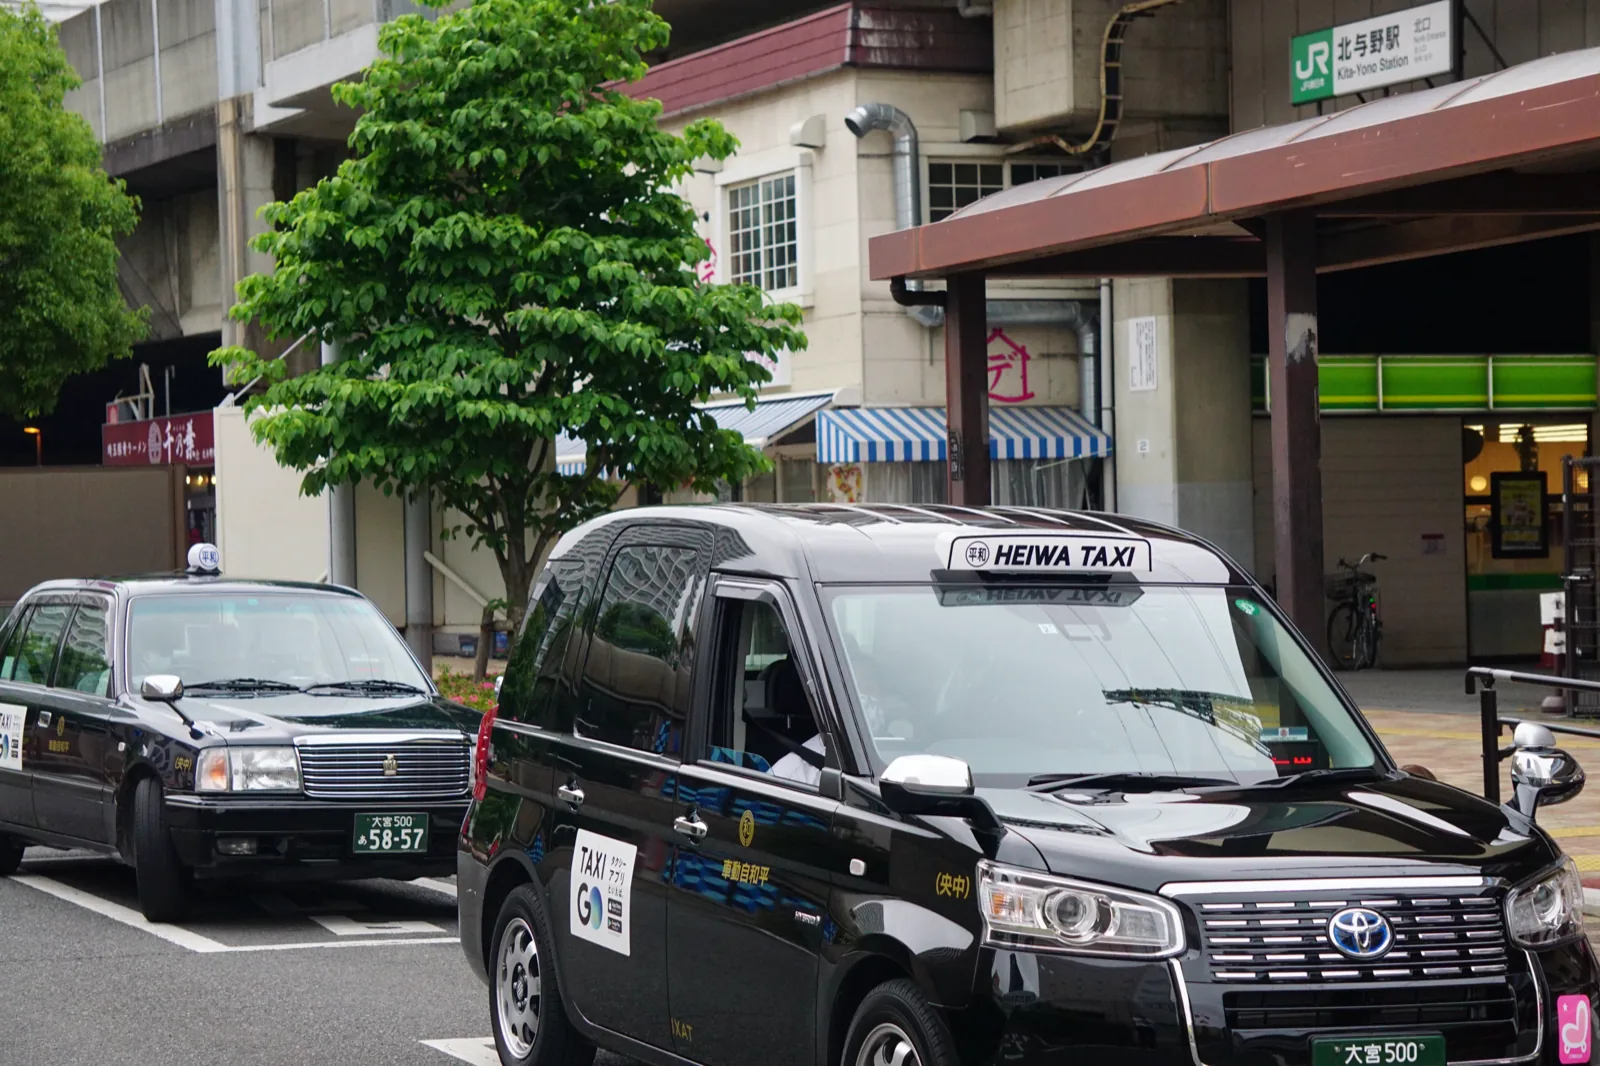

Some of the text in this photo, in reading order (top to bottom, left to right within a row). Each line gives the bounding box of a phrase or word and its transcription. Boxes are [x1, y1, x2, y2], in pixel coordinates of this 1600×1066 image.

[1413, 17, 1431, 33] 北口
[1338, 24, 1400, 62] 北与野駅
[1296, 41, 1330, 79] JR
[1337, 62, 1378, 80] Kita-Yono
[1379, 55, 1409, 72] Station
[202, 551, 217, 563] 平和
[968, 545, 1136, 567] 平和 HEIWA TAXI
[372, 816, 412, 827] 大宮500
[358, 828, 424, 850] あ 58-57
[580, 846, 607, 880] TAXI
[577, 882, 603, 930] GO
[1345, 1043, 1417, 1064] 大宮500
